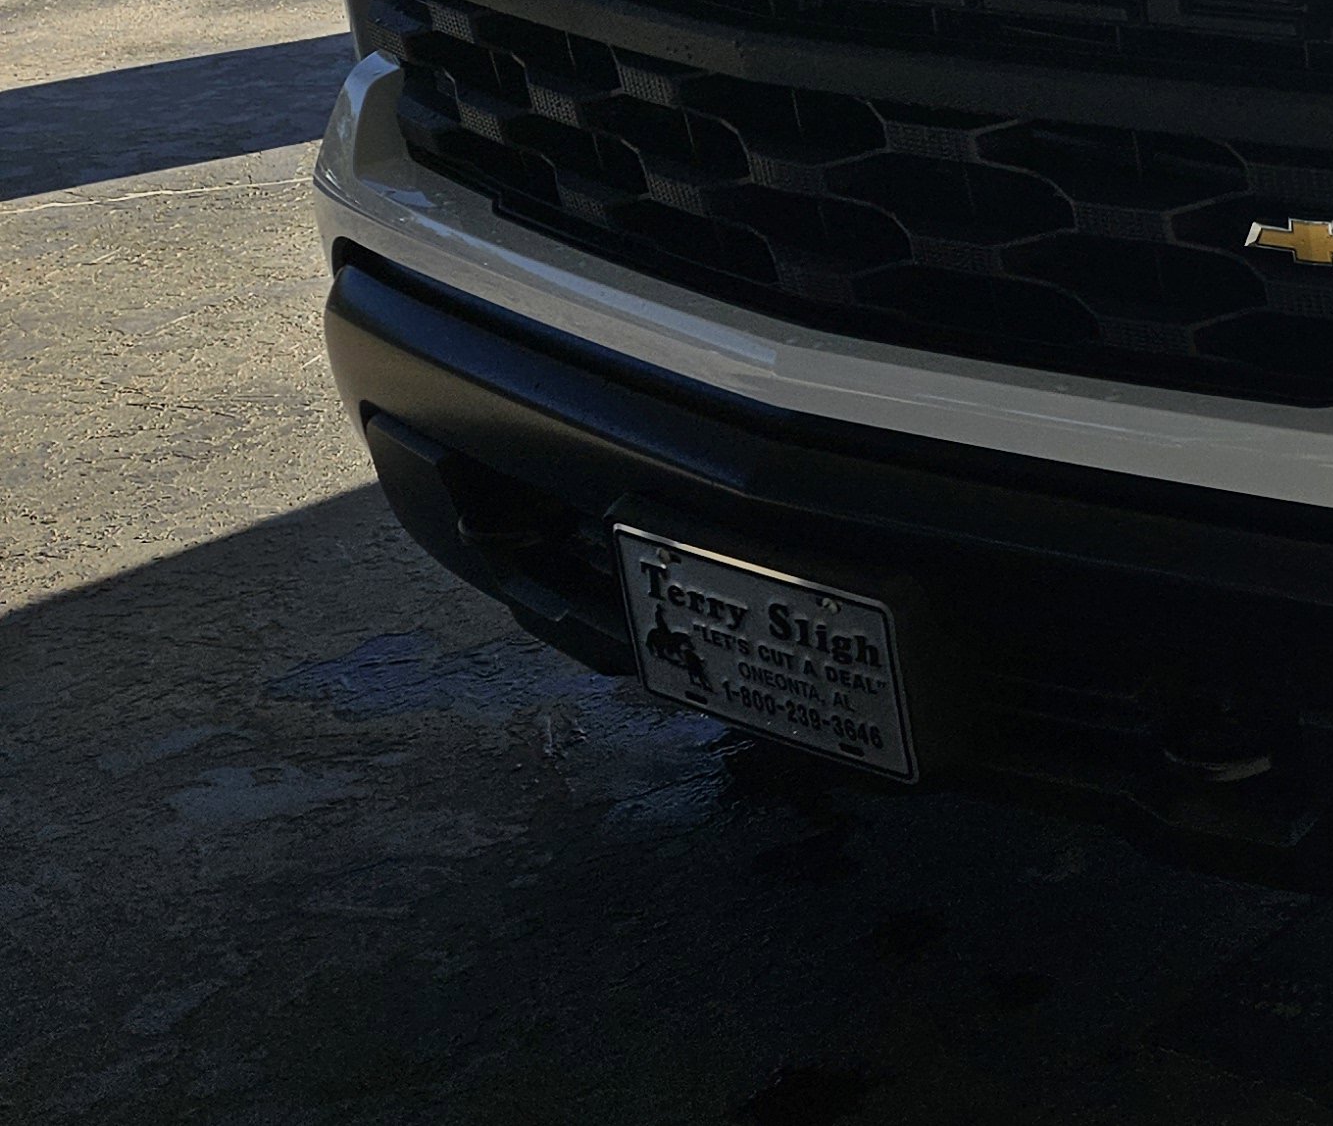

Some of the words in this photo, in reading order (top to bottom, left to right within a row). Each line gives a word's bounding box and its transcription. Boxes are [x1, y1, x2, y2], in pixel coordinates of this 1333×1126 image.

[640, 561, 748, 631] Terry
[768, 601, 883, 668] Sligh
[738, 661, 826, 707] ONEONTA,
[832, 691, 856, 714] AL
[758, 645, 796, 671] CUT
[802, 660, 818, 679] A
